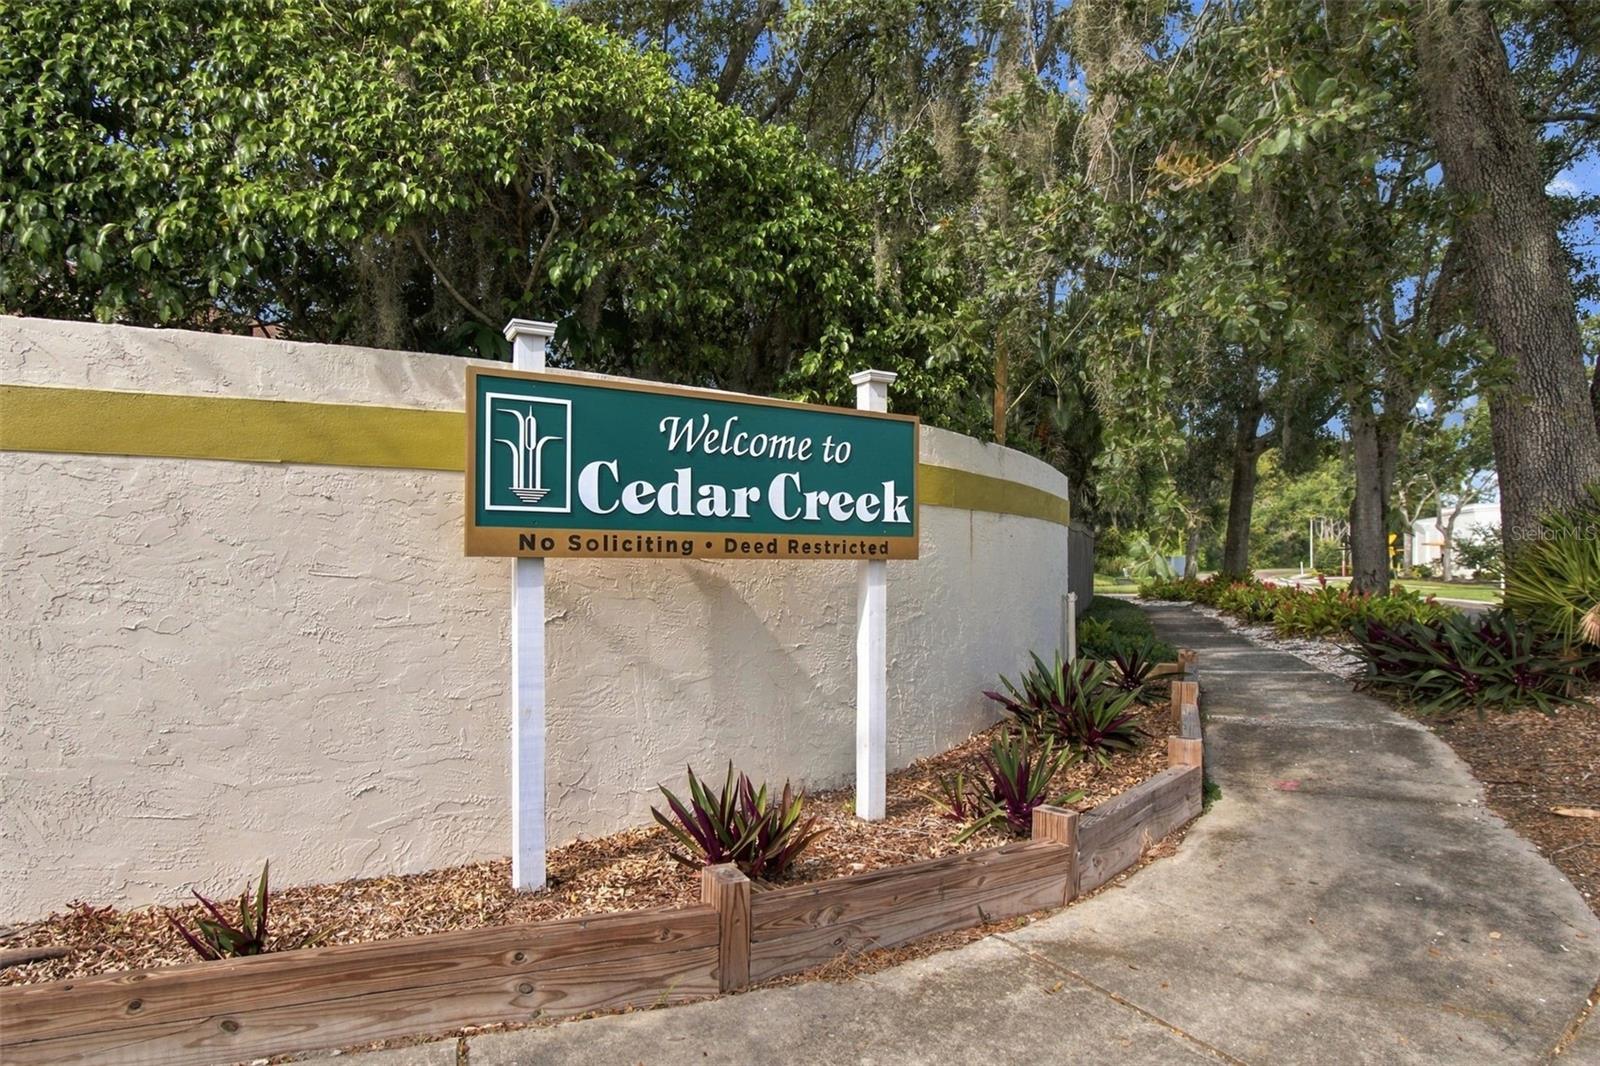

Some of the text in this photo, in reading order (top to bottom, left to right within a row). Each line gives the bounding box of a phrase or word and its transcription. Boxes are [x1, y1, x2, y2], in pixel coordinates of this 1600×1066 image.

[659, 413, 852, 464] Welcome to
[577, 459, 912, 524] Cedar Creek
[518, 533, 889, 556] No Soliciting Deed Restricted
